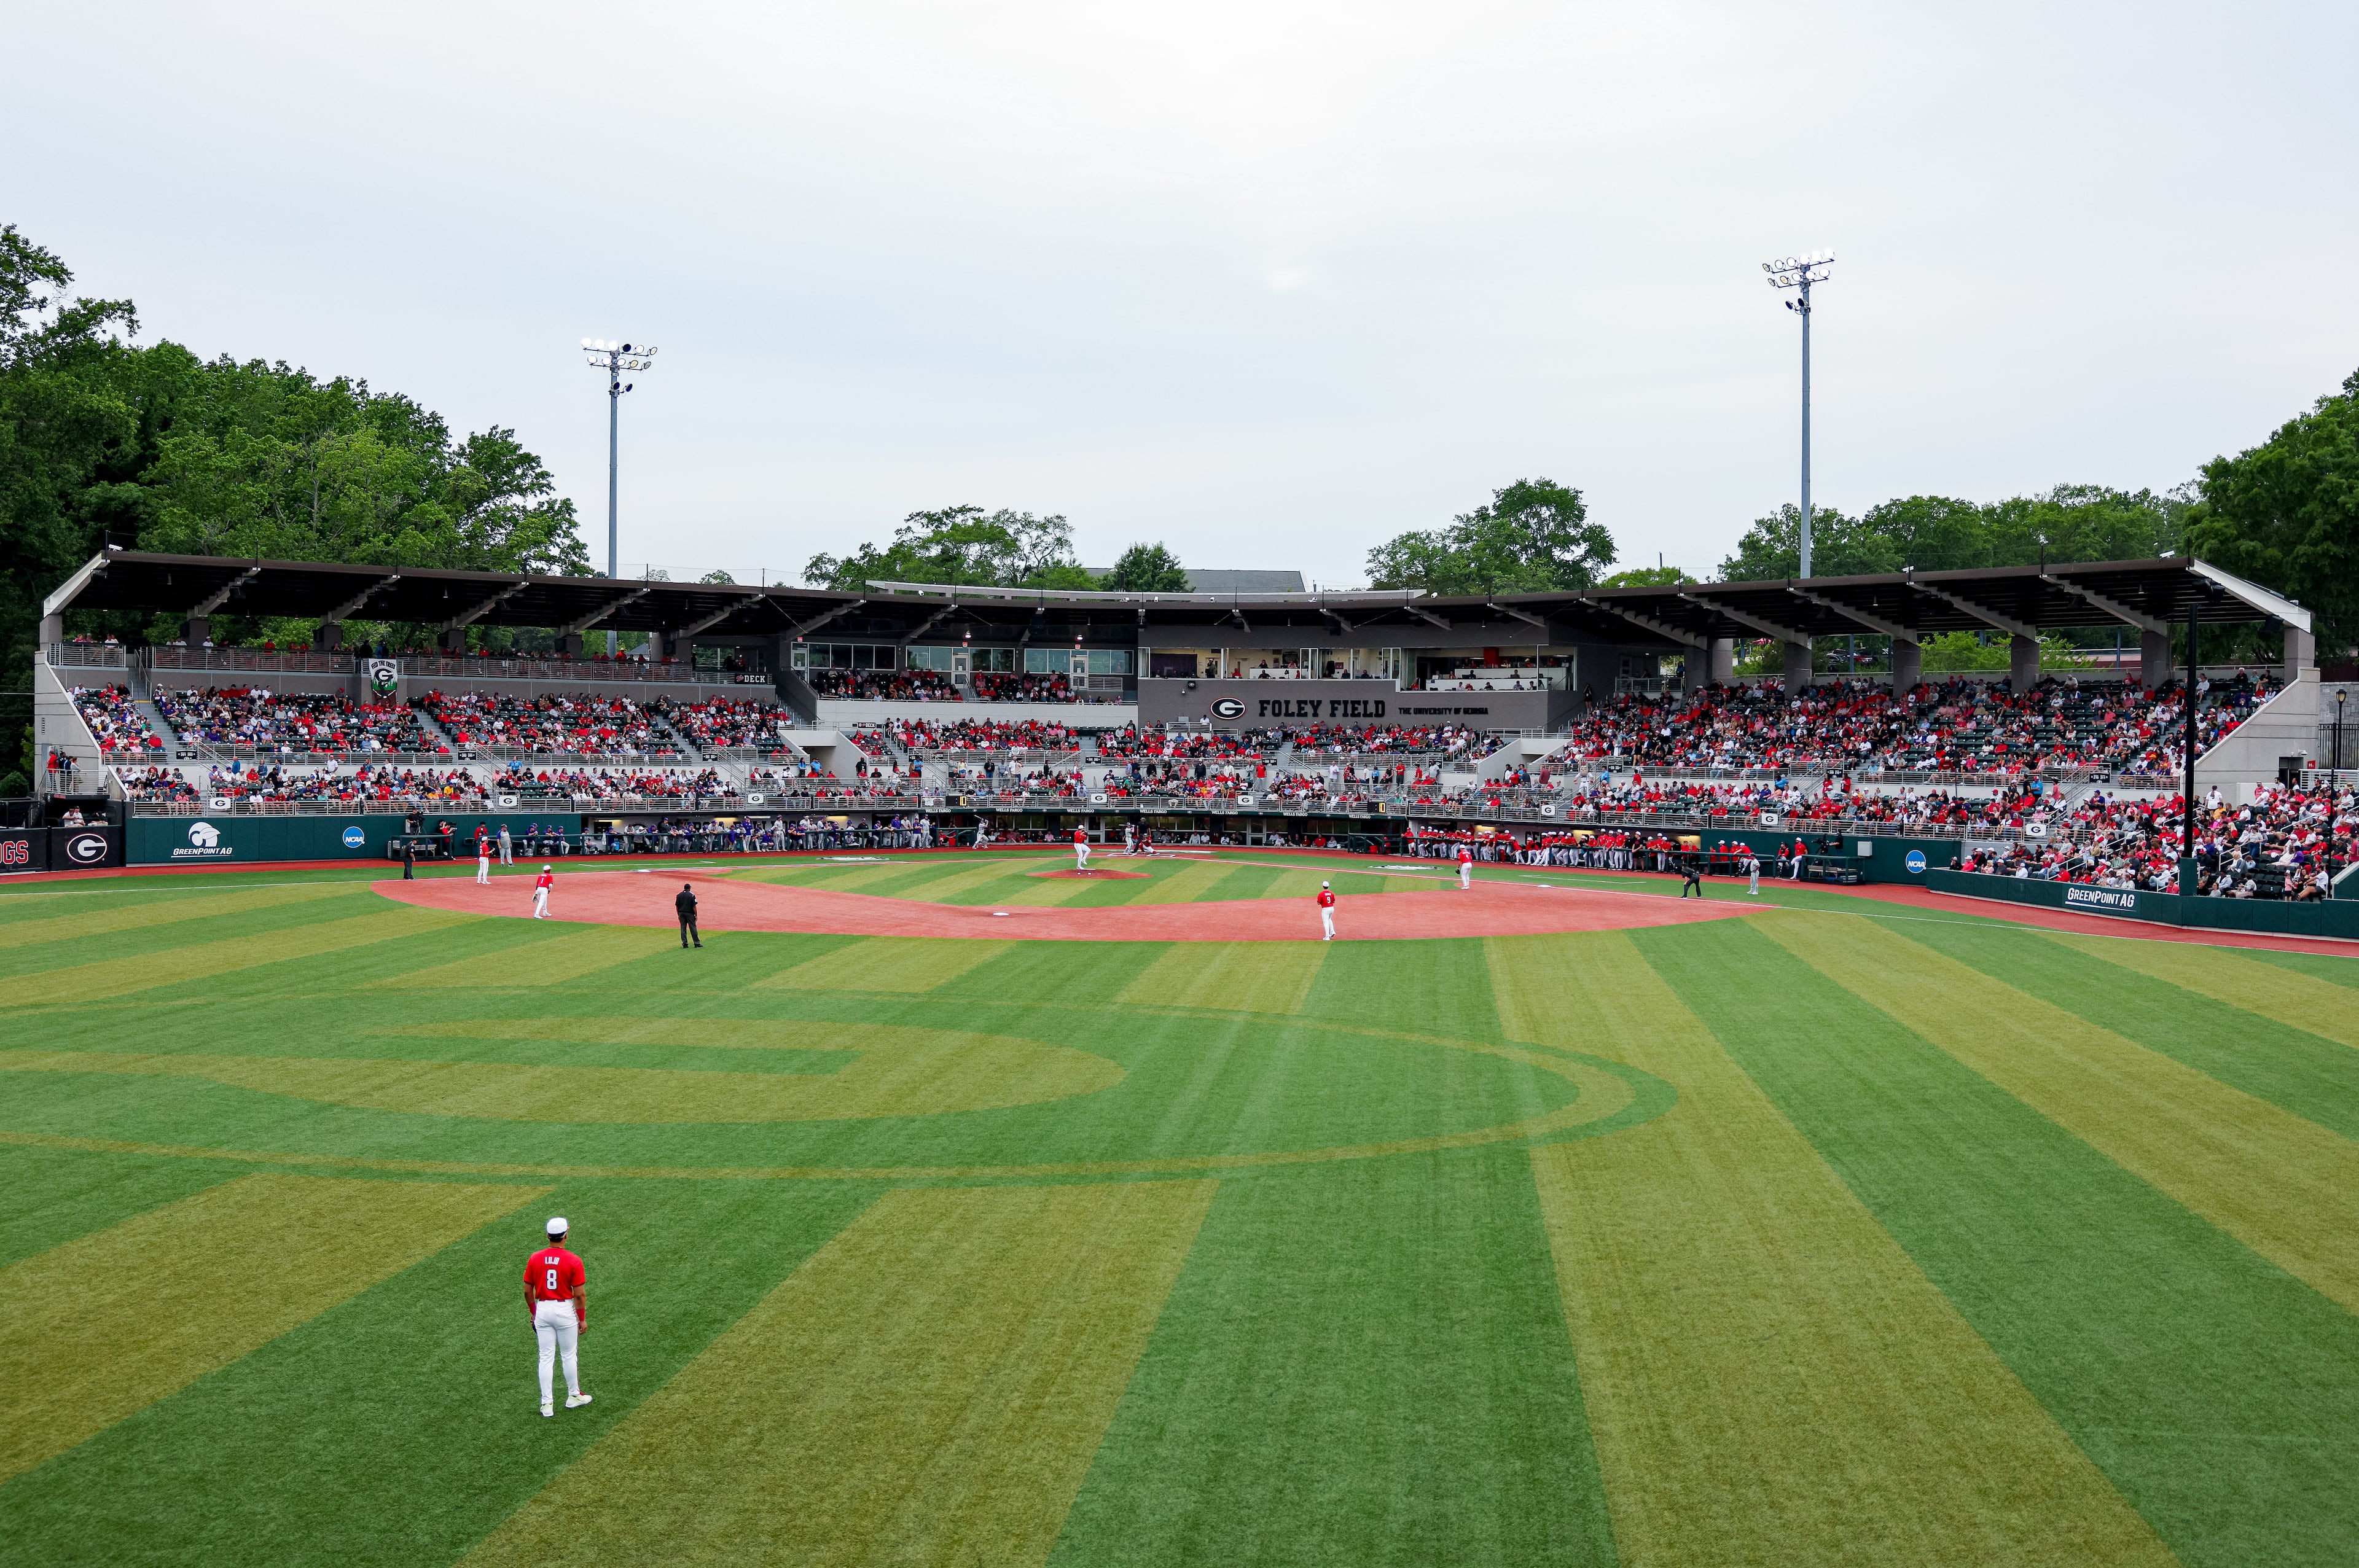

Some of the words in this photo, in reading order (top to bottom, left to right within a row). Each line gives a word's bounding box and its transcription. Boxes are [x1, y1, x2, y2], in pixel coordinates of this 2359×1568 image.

[1211, 697, 1246, 720] G
[1259, 700, 1322, 717] FOLEY
[1329, 700, 1385, 717] FIELD
[0, 840, 29, 865] GS
[67, 833, 108, 864] G
[2119, 893, 2135, 908] AG
[544, 1256, 560, 1265] LUJO
[546, 1268, 557, 1290] 8
